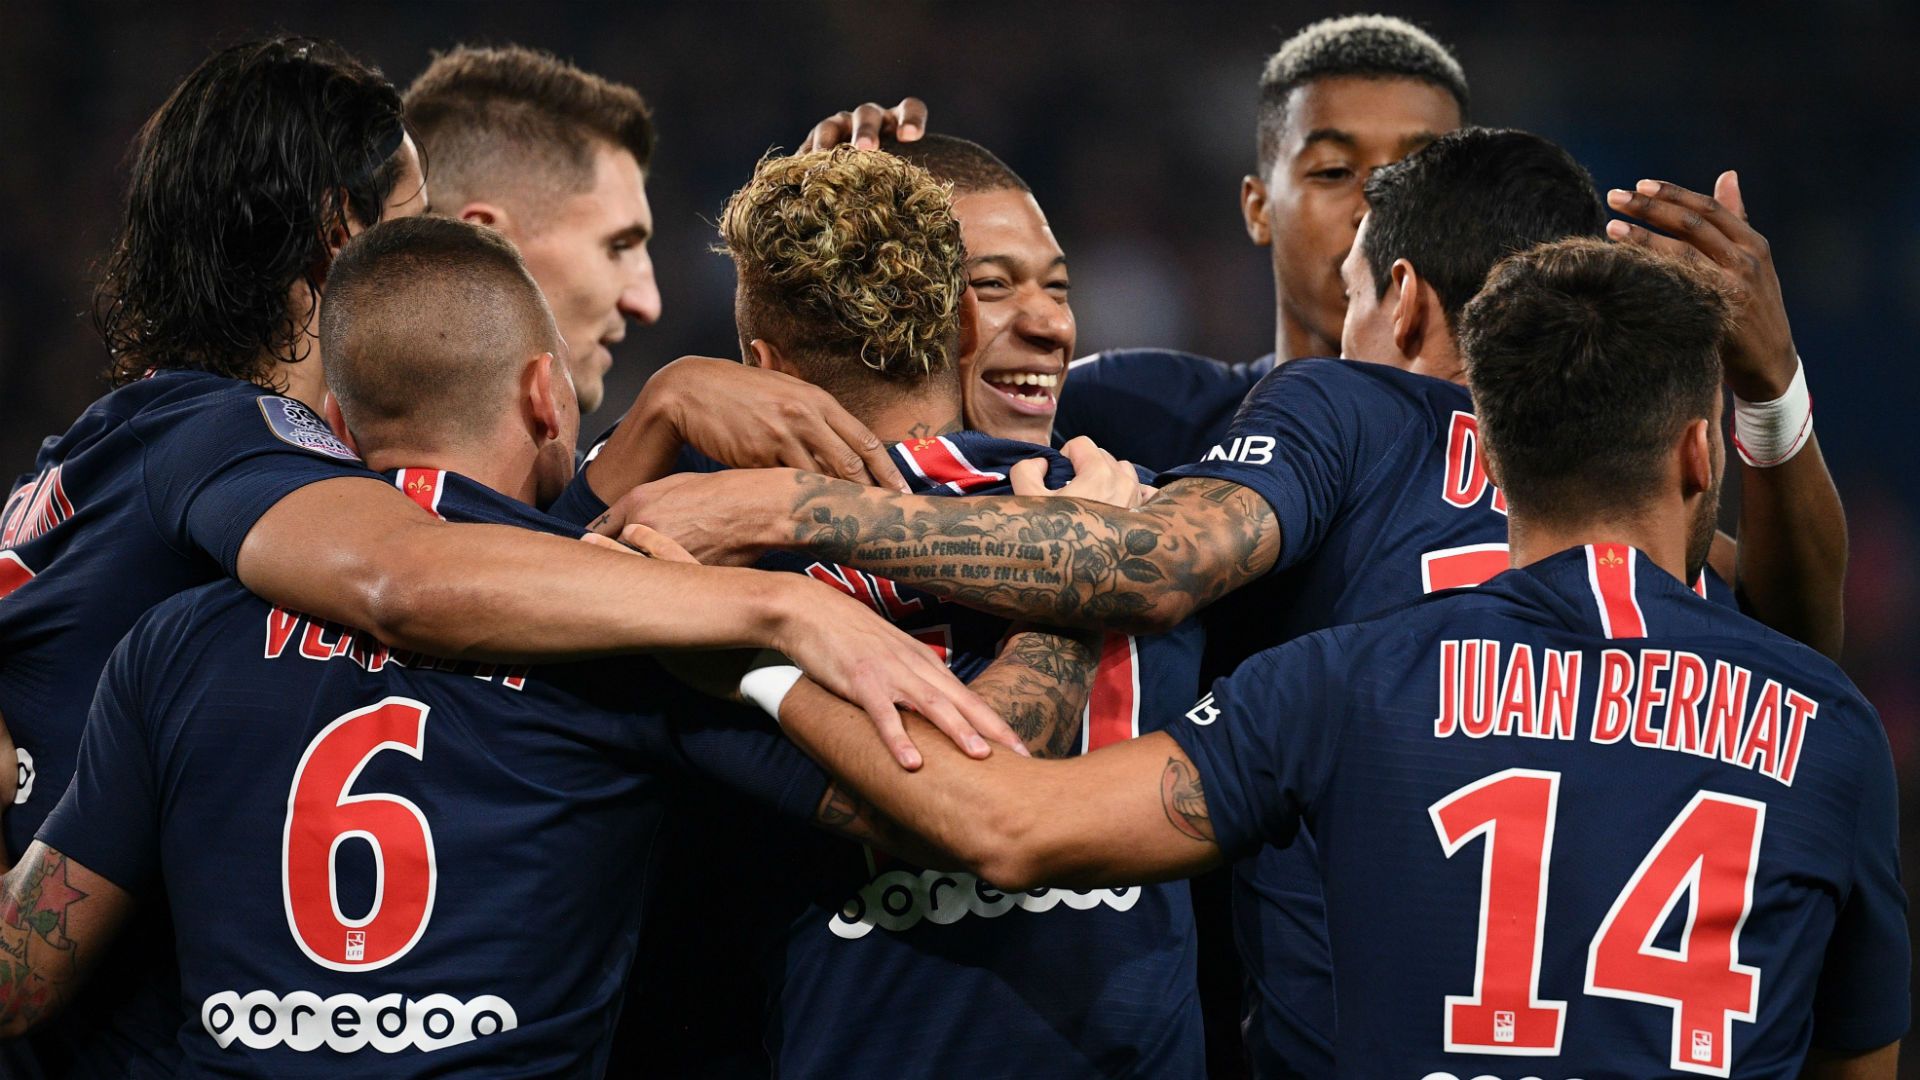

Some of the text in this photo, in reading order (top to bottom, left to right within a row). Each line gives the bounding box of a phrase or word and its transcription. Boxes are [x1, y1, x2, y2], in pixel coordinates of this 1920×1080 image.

[1200, 435, 1276, 465] NB
[1442, 410, 1508, 515] D
[913, 544, 928, 557] LA
[1007, 543, 1016, 557] Y
[914, 564, 937, 578] QUE
[1013, 567, 1028, 582] LA
[1434, 639, 1818, 787] JUAN BERNAT
[282, 696, 437, 972] 6
[1428, 767, 1767, 1078] 14
[206, 993, 506, 1043] ooredoo
